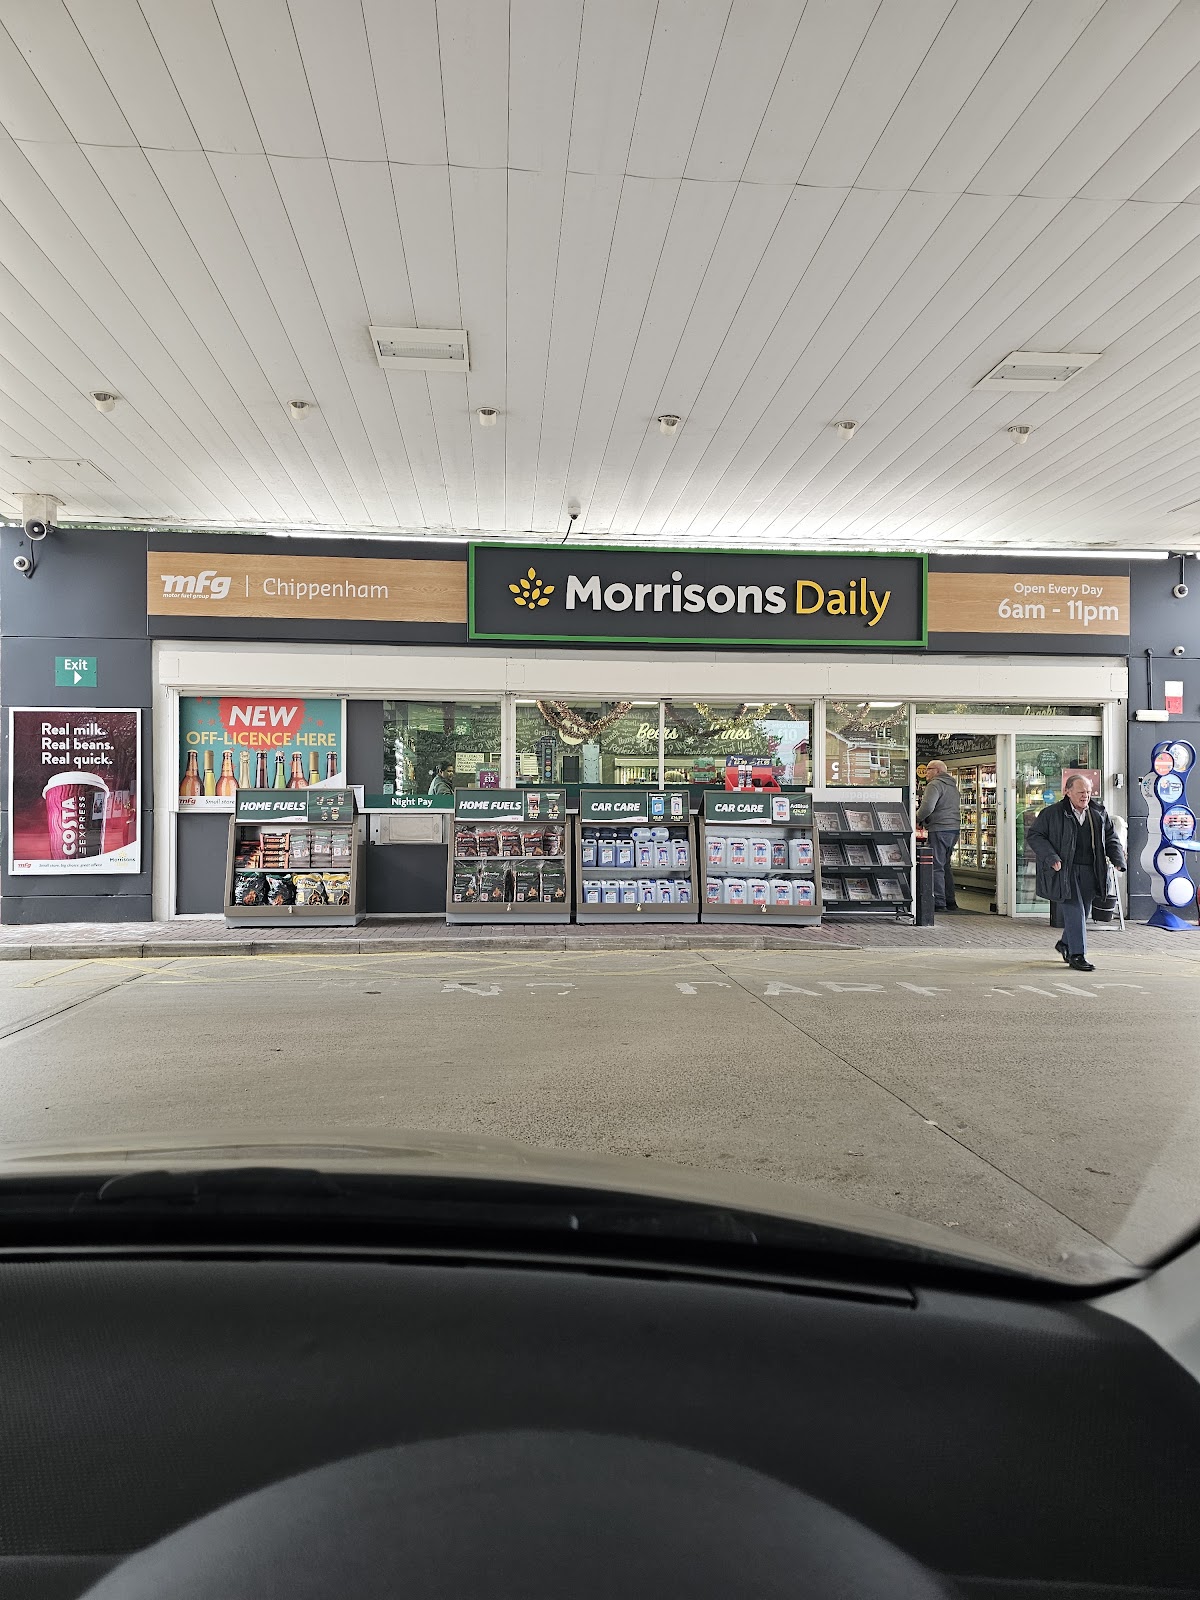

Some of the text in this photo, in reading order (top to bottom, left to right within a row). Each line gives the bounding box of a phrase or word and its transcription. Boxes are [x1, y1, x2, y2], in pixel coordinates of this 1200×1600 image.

[160, 570, 232, 599] mfg
[263, 578, 389, 600] Chippenham
[1013, 582, 1103, 598] Open Every Day
[565, 570, 892, 627] Morrisons Daily
[997, 598, 1046, 619] 6am
[1067, 600, 1119, 626] 11pm
[64, 658, 88, 671] Exit
[229, 705, 298, 726] NEW
[41, 722, 107, 735] Real milk.
[41, 737, 115, 750] Real beans.
[186, 731, 336, 746] OFF-LICENCE HERE
[41, 752, 114, 769] Real quick.
[240, 801, 306, 811] HOME FUELS
[391, 797, 433, 807] Night Pay
[459, 801, 522, 810] HOME FUELS
[591, 802, 641, 812] CAR CARE
[714, 803, 764, 813] CAR CARE
[62, 797, 78, 856] COSTA
